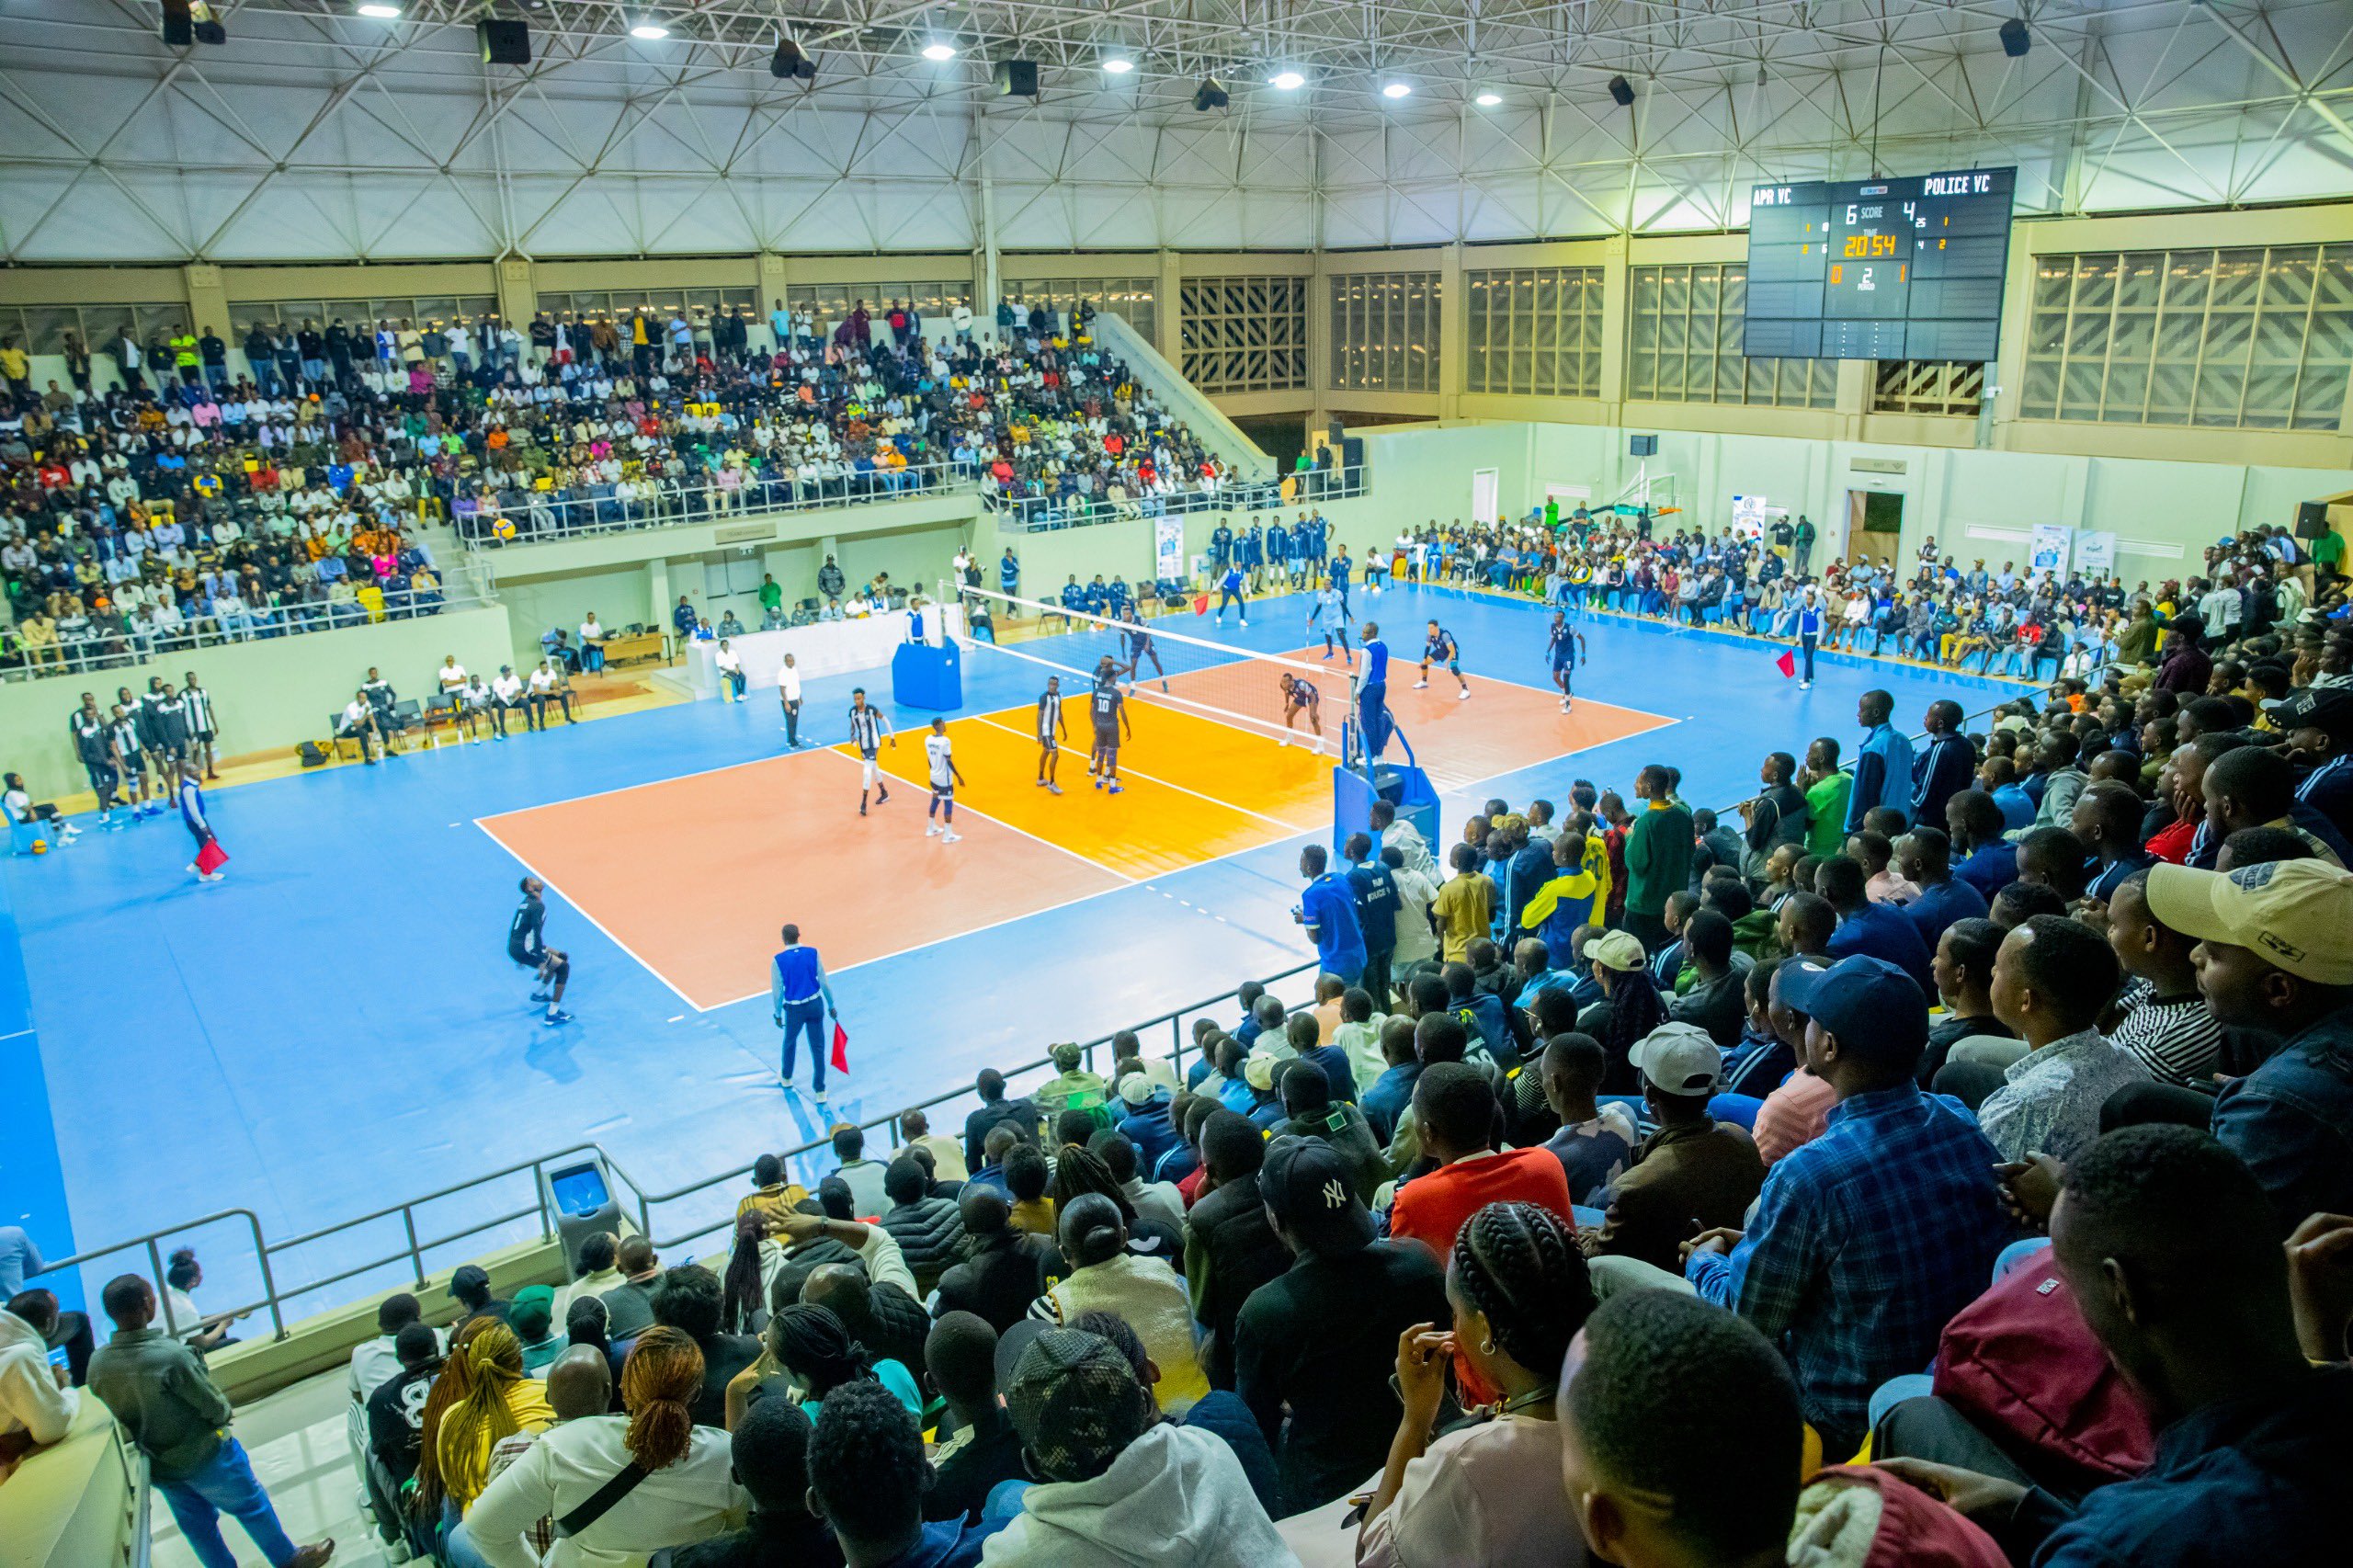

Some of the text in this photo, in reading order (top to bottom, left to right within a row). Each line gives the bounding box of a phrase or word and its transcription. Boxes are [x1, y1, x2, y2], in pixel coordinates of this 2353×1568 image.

[1924, 175, 1990, 196] POLICE VC
[1753, 187, 1791, 206] APR VC
[1846, 204, 1858, 225] 6
[1860, 206, 1883, 220] SCORE
[1903, 201, 1915, 222] 4
[1844, 234, 1896, 256] 20 54
[1830, 265, 1842, 284] 0
[1861, 267, 1873, 283] 2
[1097, 699, 1110, 713] 10
[1322, 1178, 1347, 1209] NY
